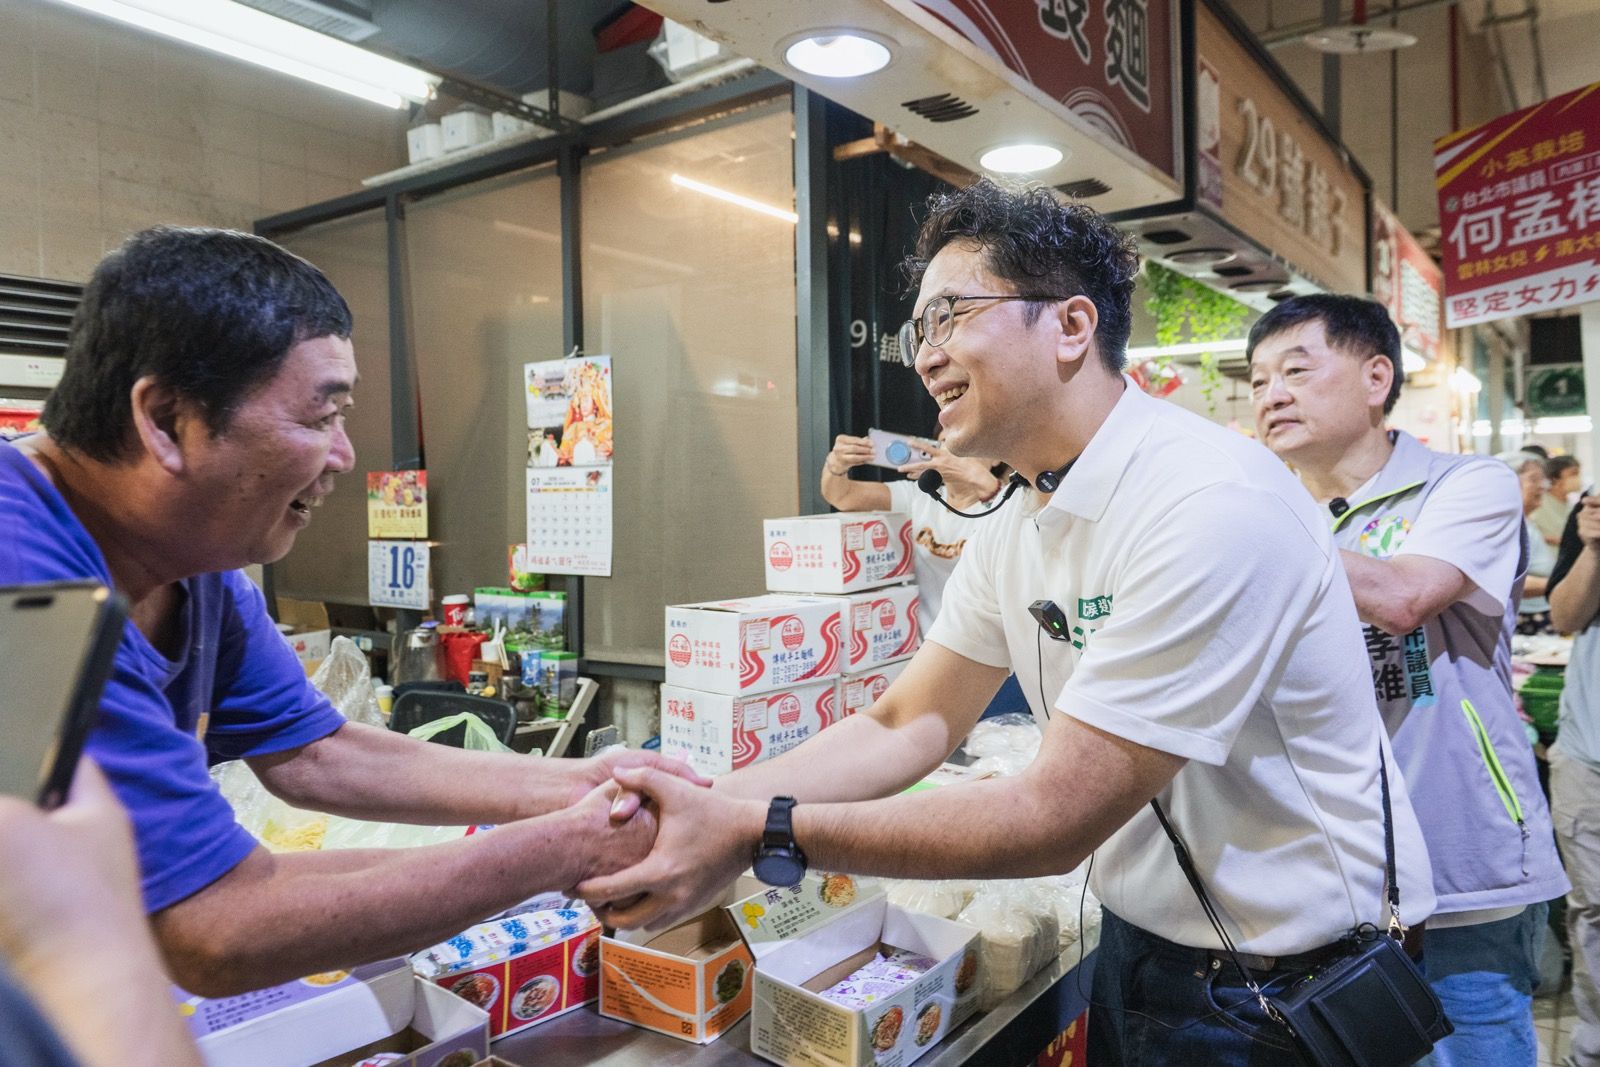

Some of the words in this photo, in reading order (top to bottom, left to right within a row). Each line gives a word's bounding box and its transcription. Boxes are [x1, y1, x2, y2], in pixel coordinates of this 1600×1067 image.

[1480, 130, 1585, 178] 小英栽培
[1462, 169, 1547, 209] 台北市議員
[1452, 276, 1577, 320] 堅定女力
